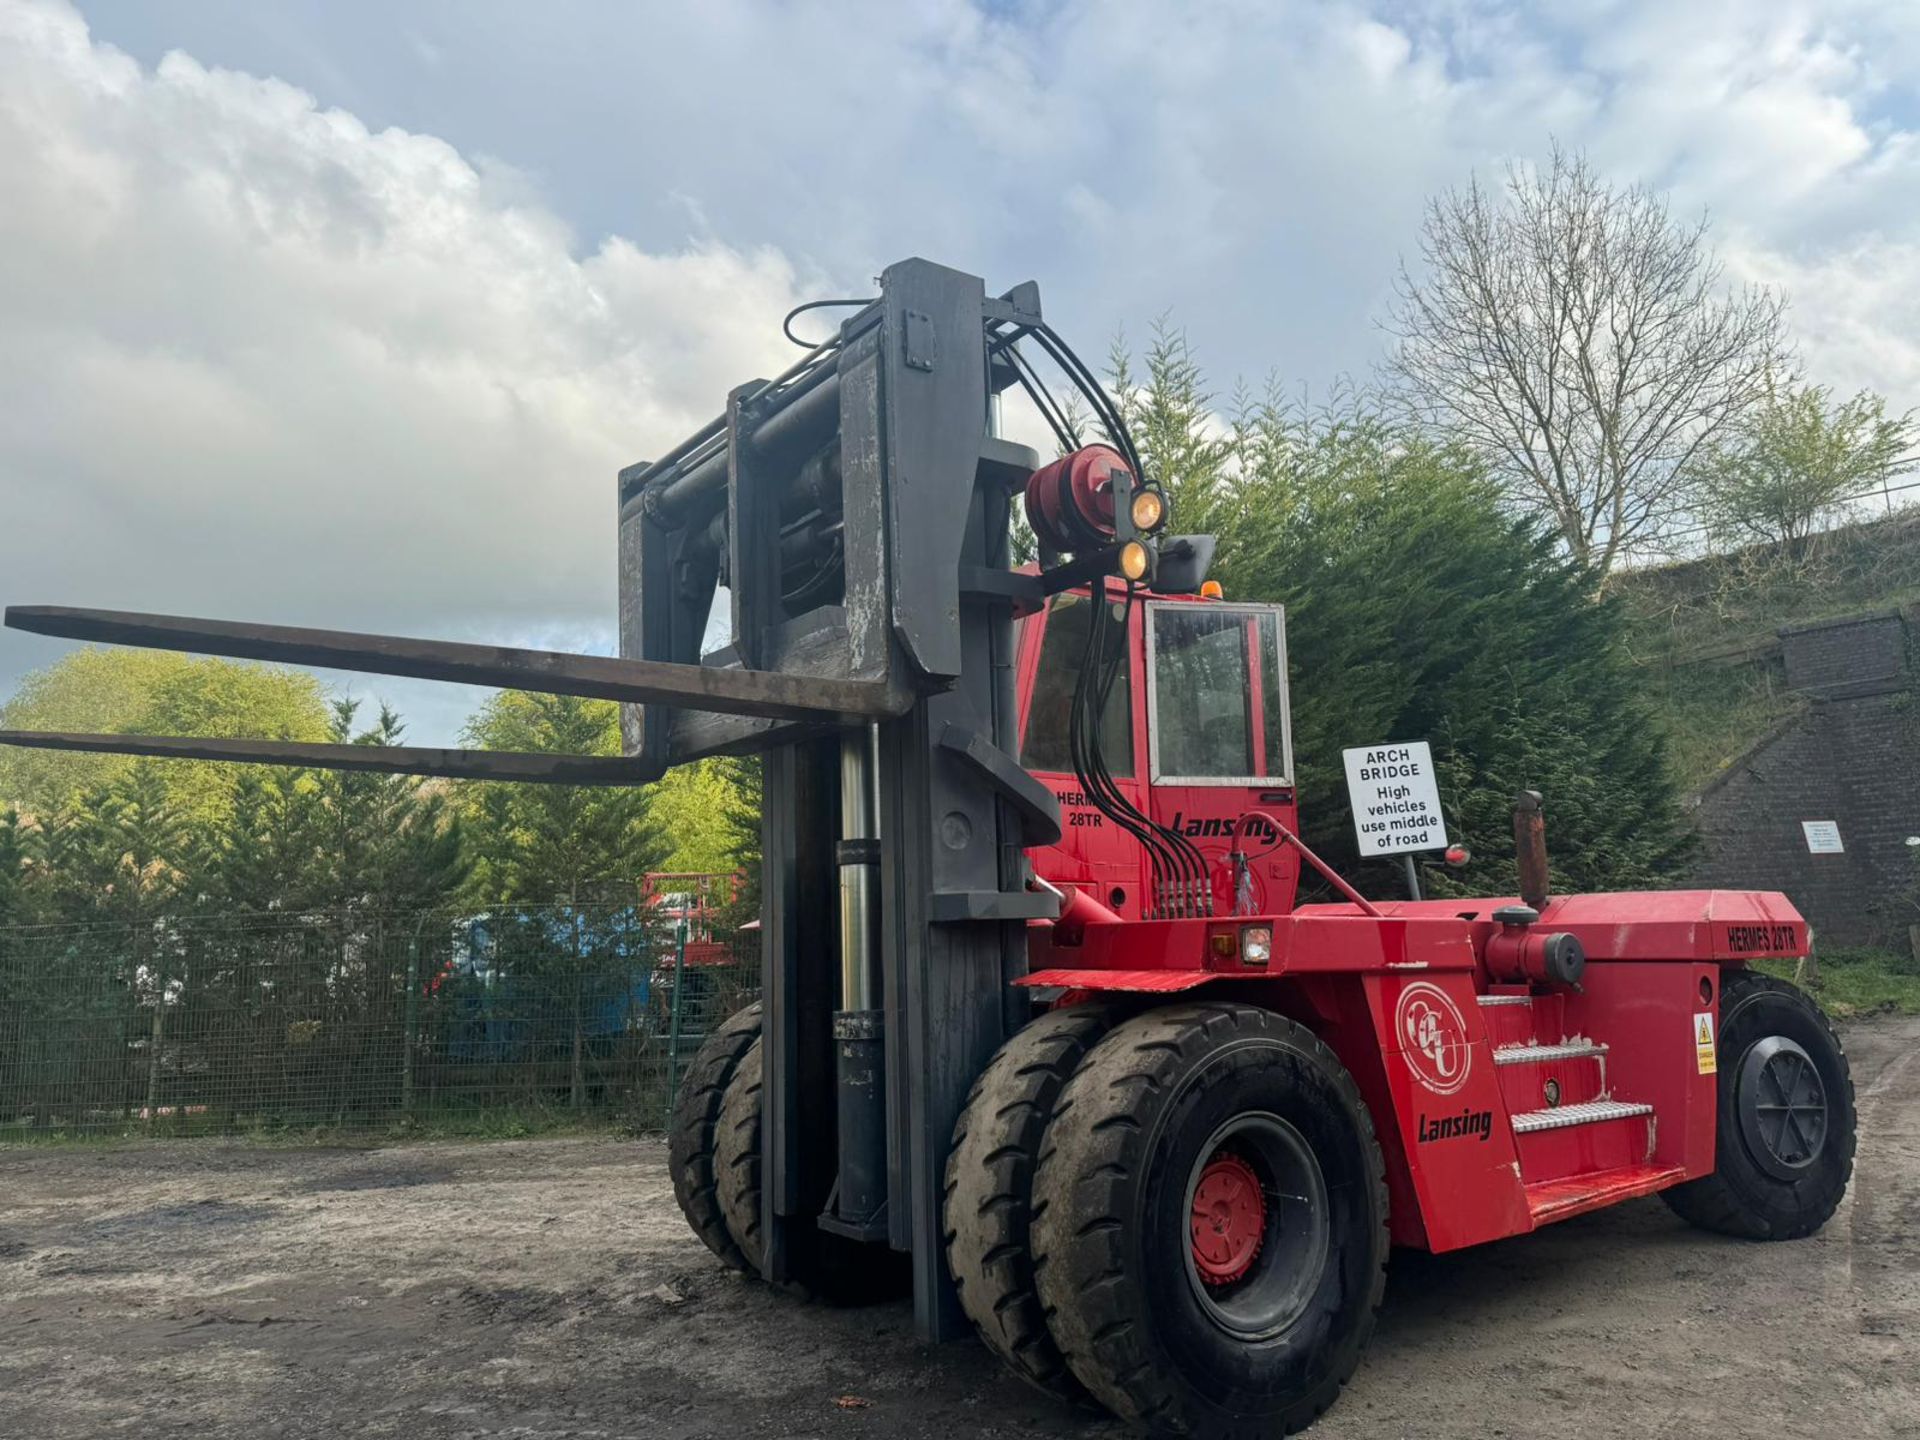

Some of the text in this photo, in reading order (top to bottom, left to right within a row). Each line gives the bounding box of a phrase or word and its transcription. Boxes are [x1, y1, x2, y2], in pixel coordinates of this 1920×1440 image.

[1367, 749, 1410, 764] ARCH
[1360, 764, 1420, 781] BRIDGE
[1057, 791, 1102, 807] HER
[1377, 785, 1410, 800] High
[1368, 801, 1426, 816] vehicles
[1069, 812, 1102, 827] 28TR
[1361, 815, 1438, 833] use middle
[1172, 811, 1281, 845] Lansng
[1377, 831, 1429, 847] of road
[1728, 925, 1797, 952] HERMES 28TR
[1418, 1108, 1492, 1143] Lansing
